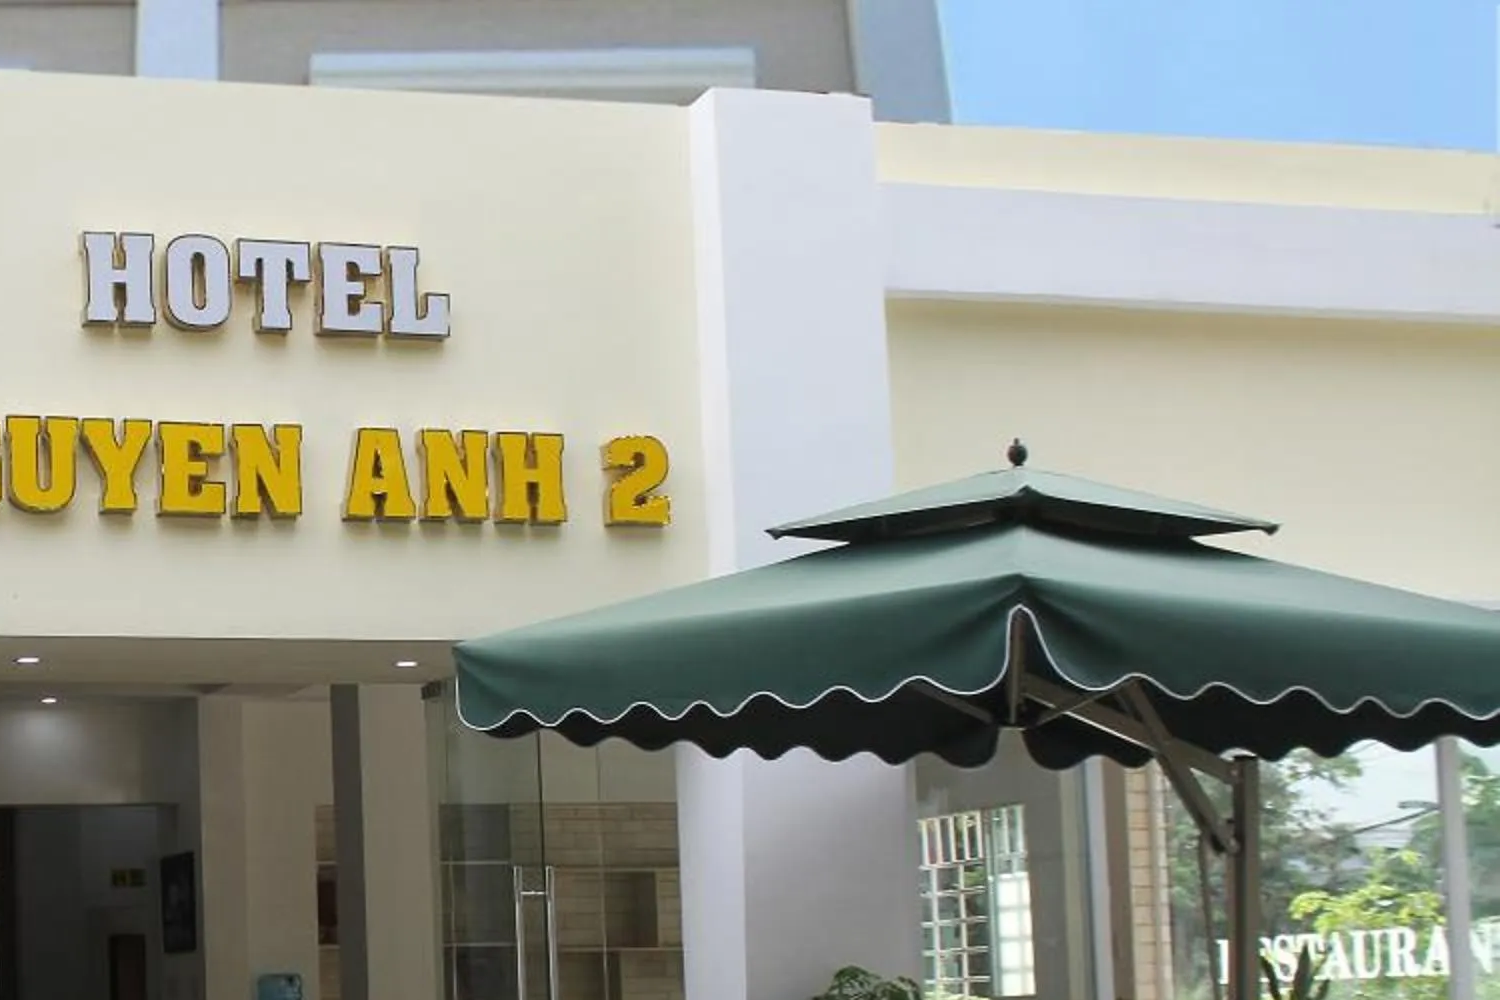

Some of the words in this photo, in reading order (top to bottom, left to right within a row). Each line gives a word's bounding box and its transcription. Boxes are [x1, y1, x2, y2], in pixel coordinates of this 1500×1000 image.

[81, 230, 451, 341] HOTEL
[342, 427, 567, 526] ANH
[602, 434, 671, 526] 2
